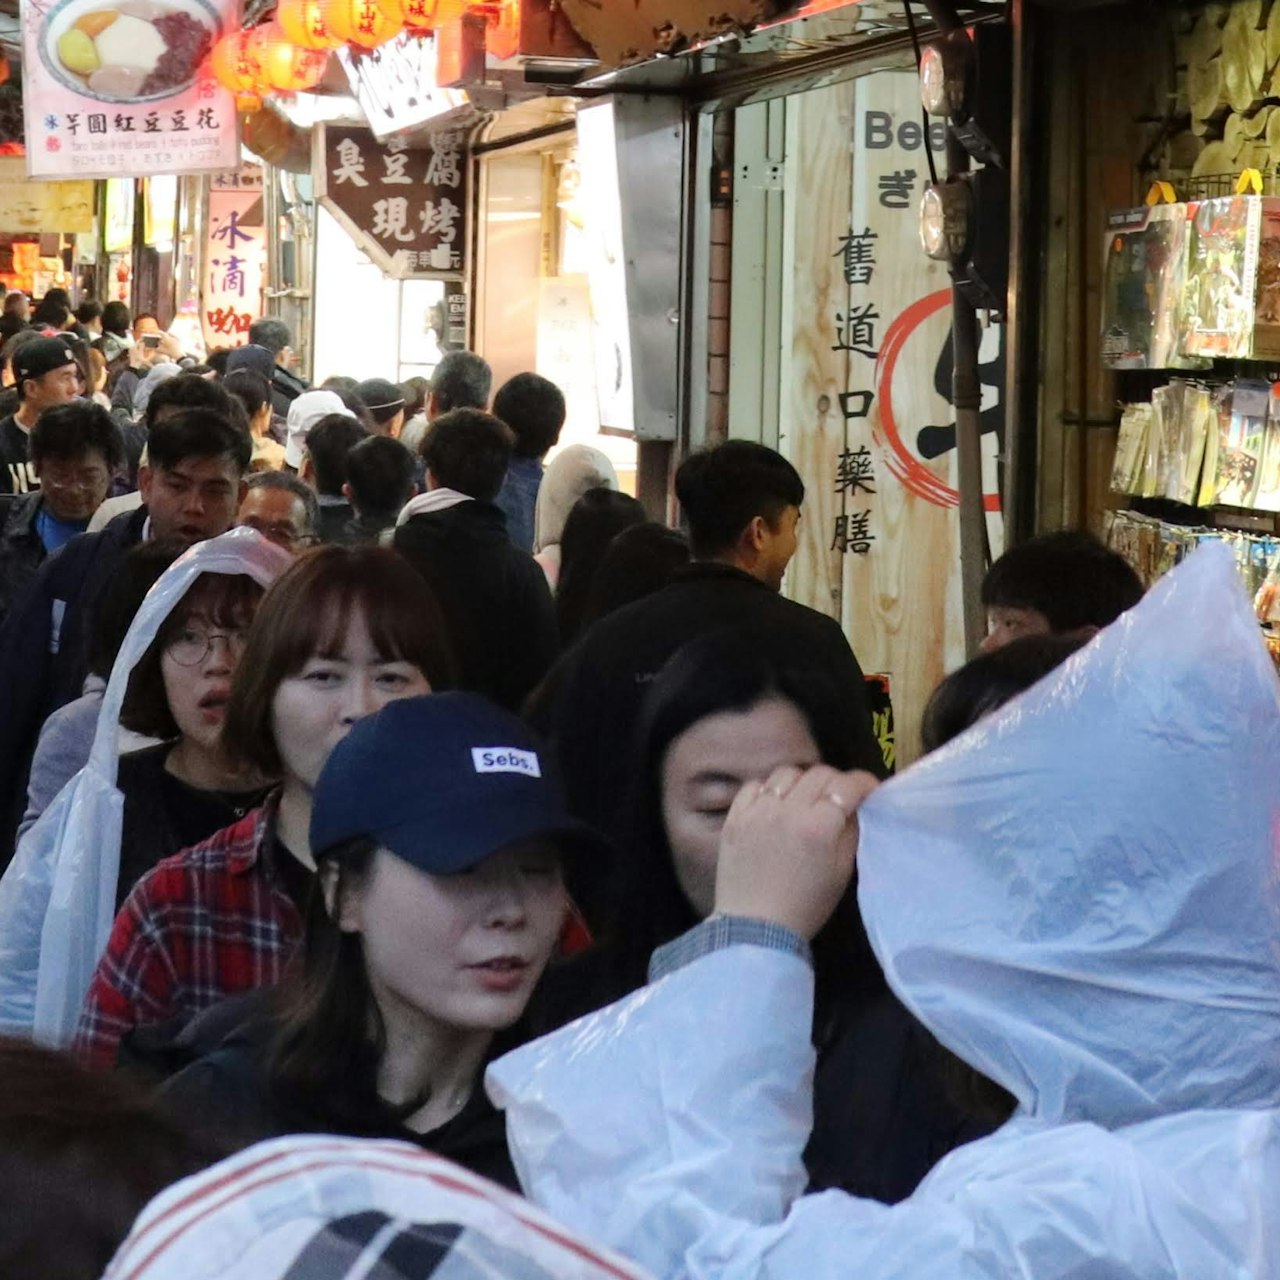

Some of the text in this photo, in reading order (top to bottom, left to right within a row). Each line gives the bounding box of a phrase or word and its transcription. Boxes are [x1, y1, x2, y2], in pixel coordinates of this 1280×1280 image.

[372, 196, 462, 244] 現烤
[406, 248, 461, 269] 每串元
[207, 209, 255, 350] 冰滴咖
[830, 227, 880, 555] 舊道口藥膳
